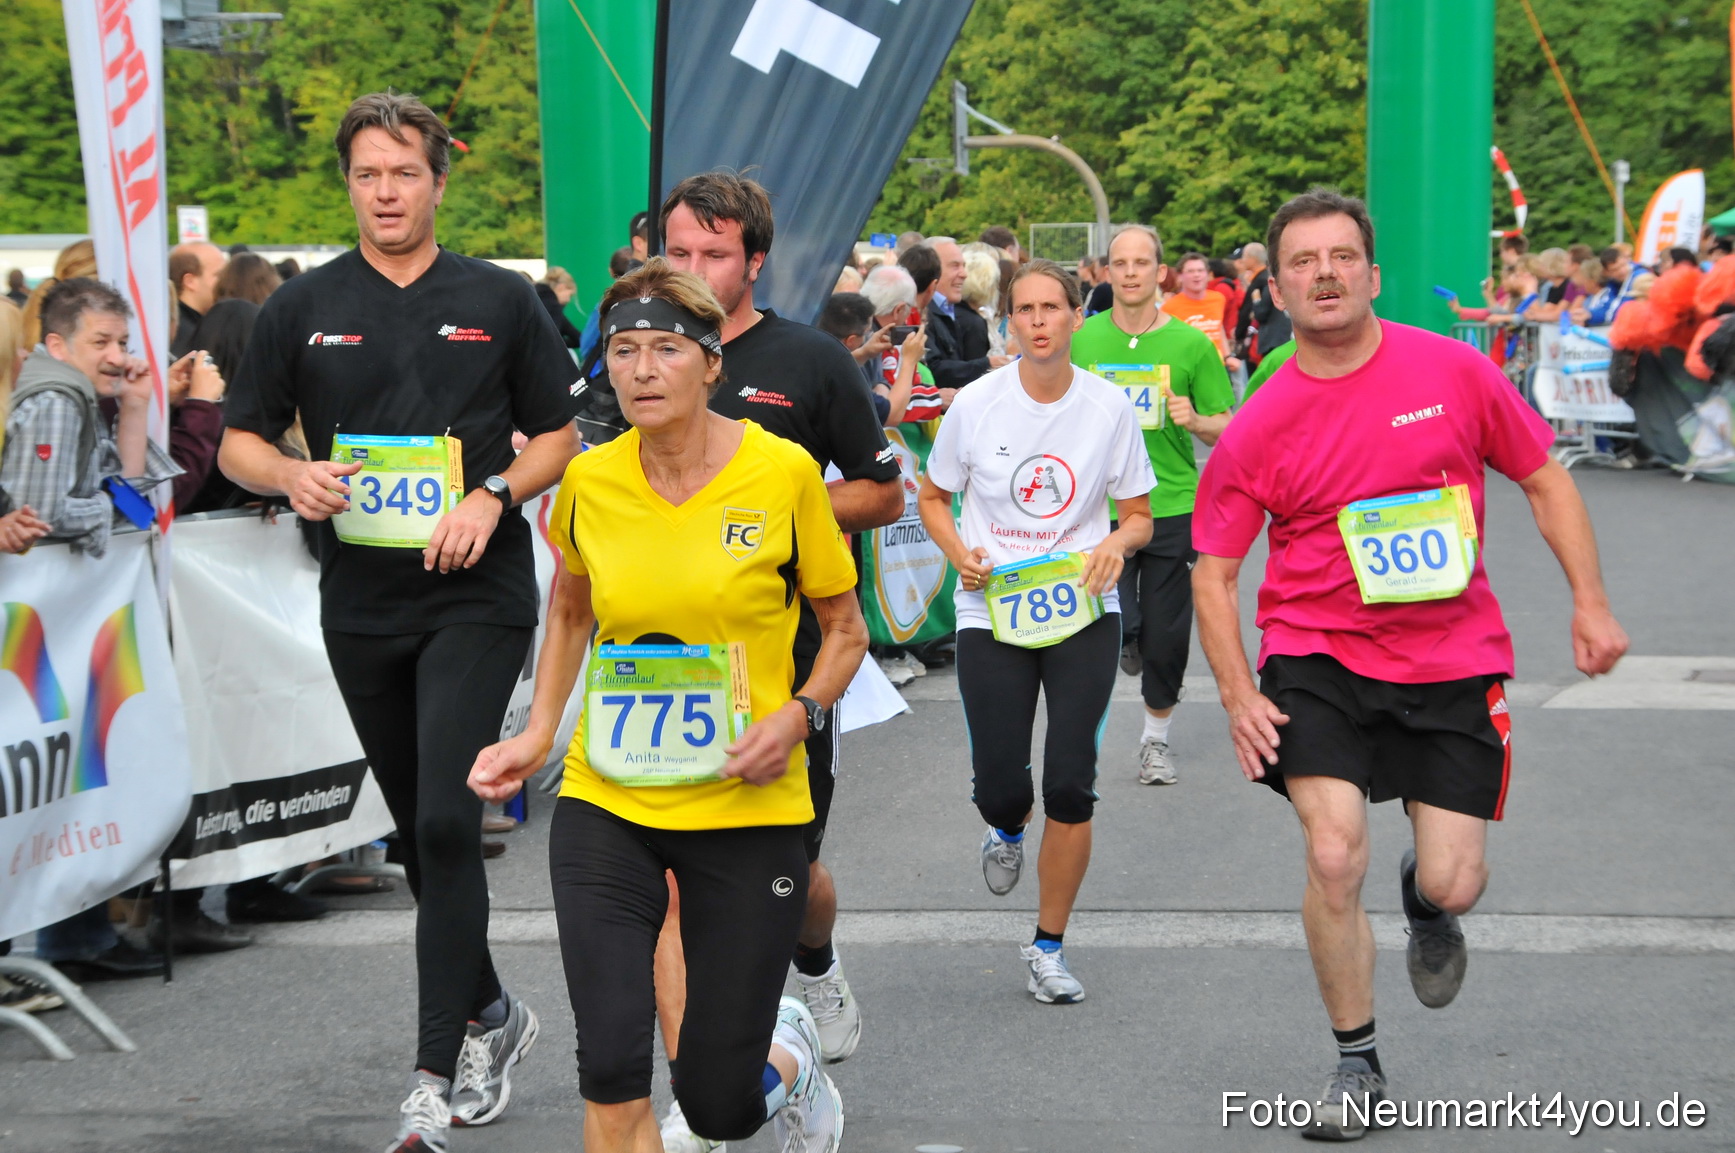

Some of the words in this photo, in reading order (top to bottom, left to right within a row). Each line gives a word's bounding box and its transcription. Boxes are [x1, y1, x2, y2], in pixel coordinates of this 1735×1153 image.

[447, 334, 491, 342] HOFFMANN
[746, 395, 794, 408] HOFFMANN
[756, 390, 785, 400] Reifen
[1400, 404, 1443, 423] DAHMIT
[725, 523, 759, 547] FC
[1036, 531, 1058, 541] MIT
[1009, 543, 1031, 552] Heck
[1361, 529, 1449, 576] 360
[1385, 576, 1417, 587] Gerald
[999, 582, 1077, 629] 789
[1015, 624, 1050, 638] Claudia
[605, 673, 655, 685] firmenlauf
[601, 694, 716, 748] 775
[624, 752, 661, 764] Anita
[245, 799, 276, 825] die
[279, 784, 352, 820] verbinden
